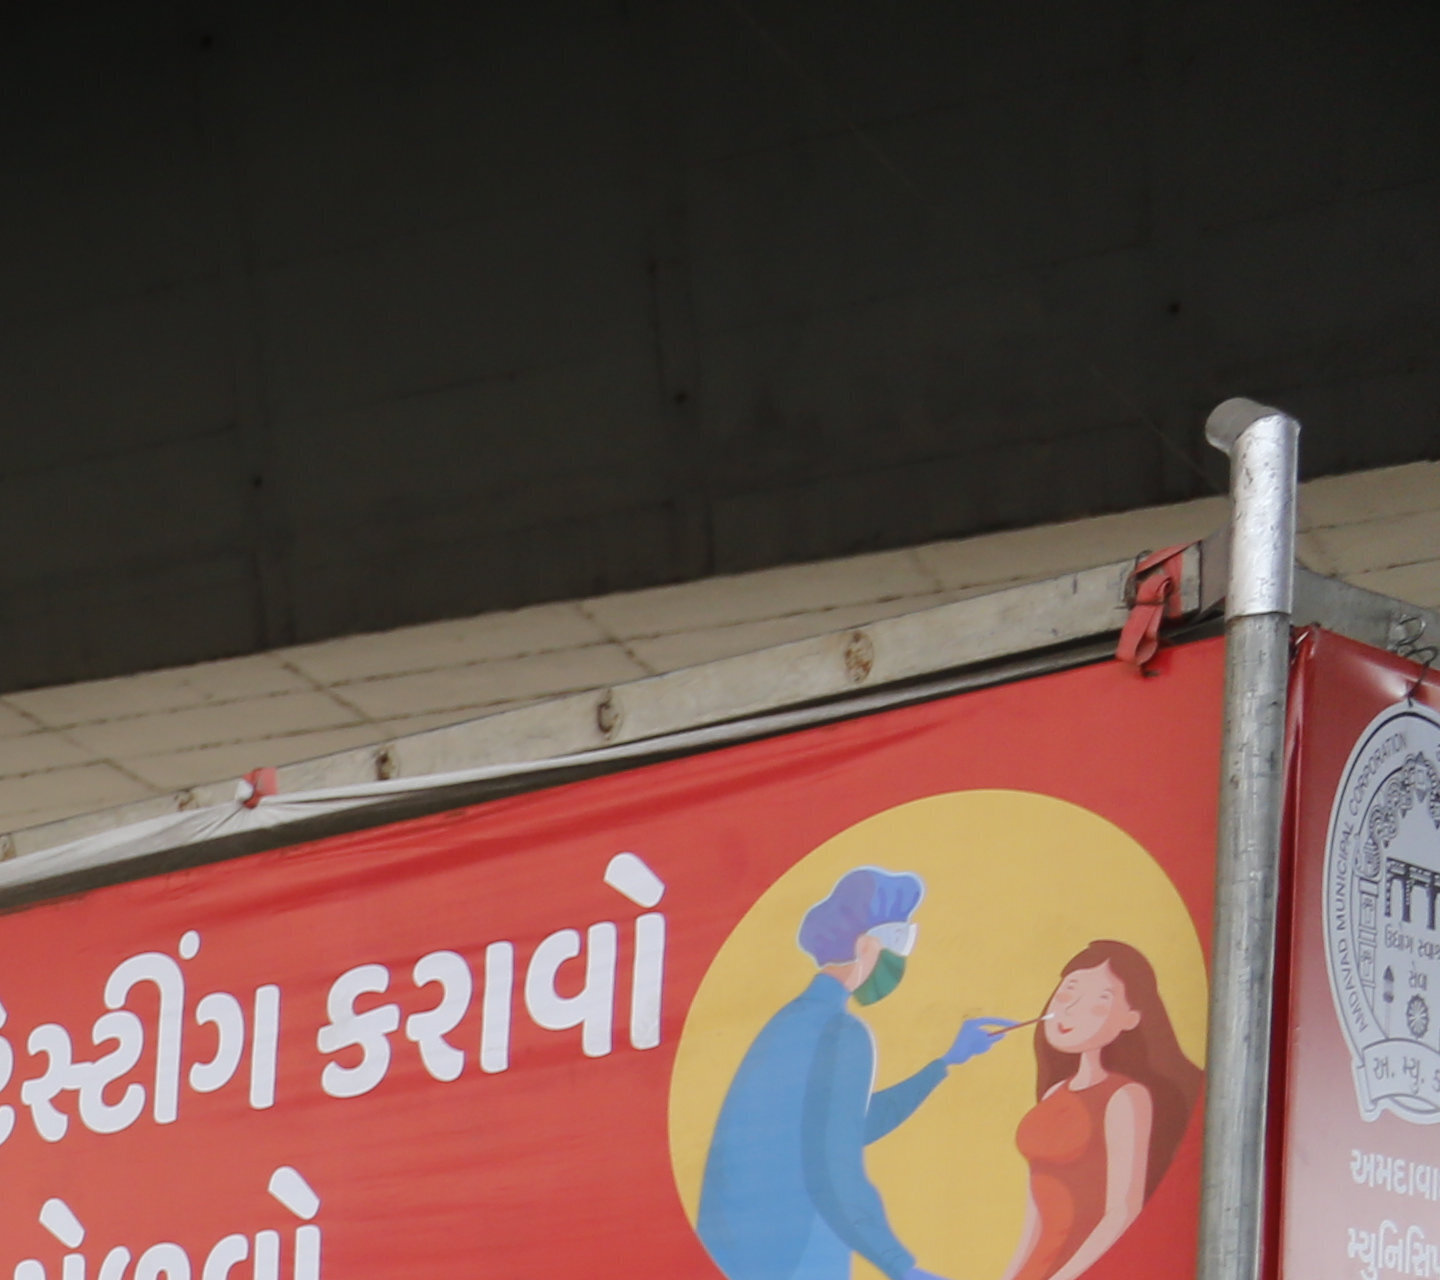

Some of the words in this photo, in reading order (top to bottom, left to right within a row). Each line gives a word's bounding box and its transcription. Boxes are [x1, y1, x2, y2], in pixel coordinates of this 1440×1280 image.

[1334, 820, 1353, 931] MUNICIPAL
[1348, 733, 1406, 816] CORPORATION
[317, 852, 666, 1099] કરાવો
[1350, 1149, 1440, 1200] અમદાવા
